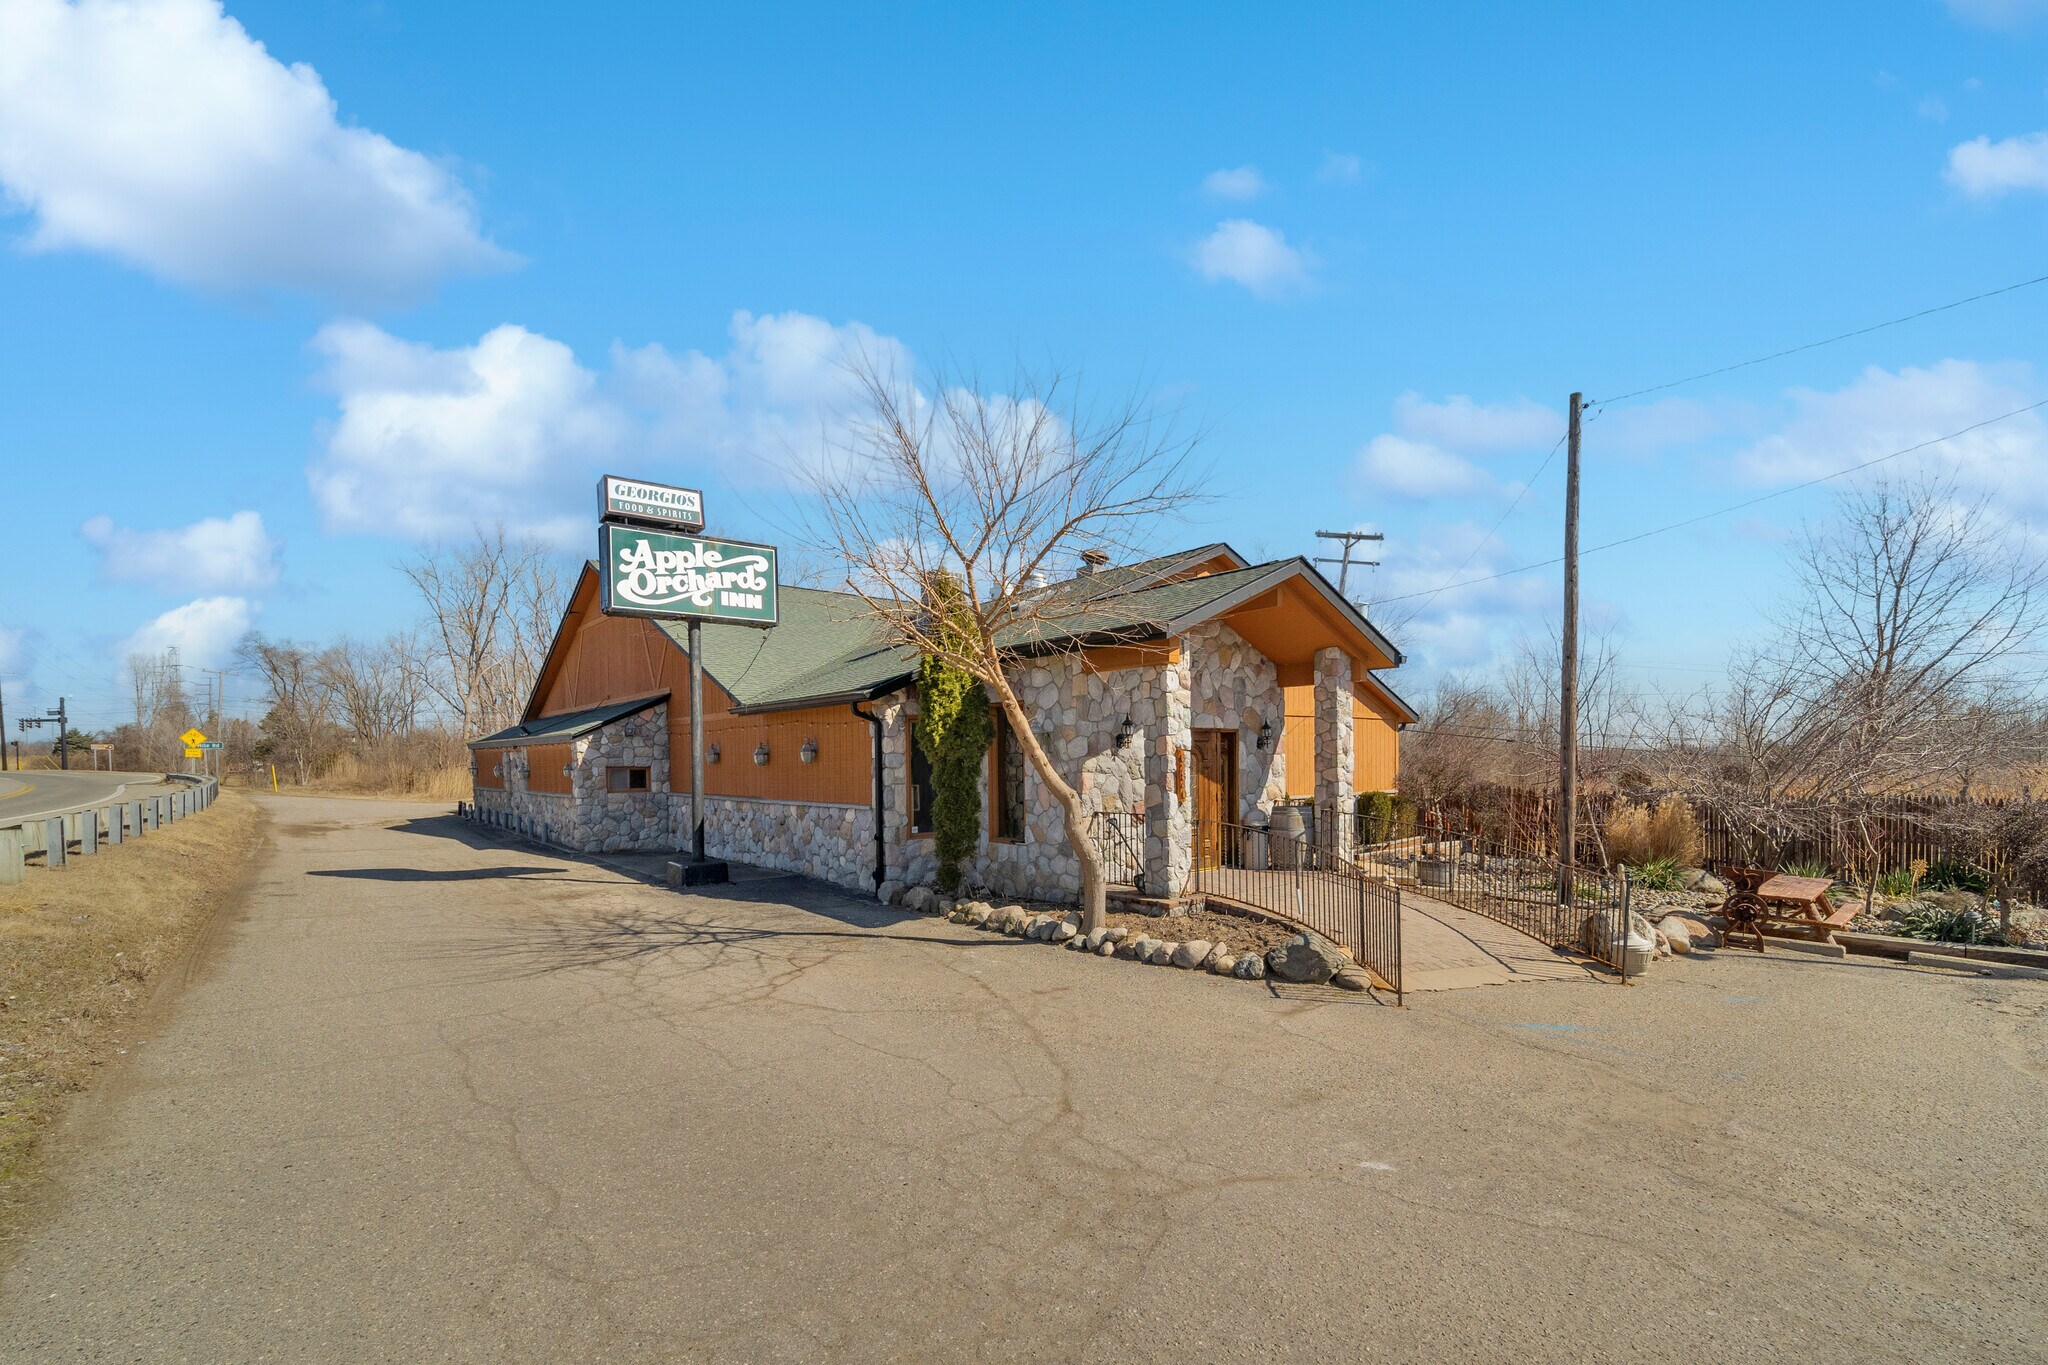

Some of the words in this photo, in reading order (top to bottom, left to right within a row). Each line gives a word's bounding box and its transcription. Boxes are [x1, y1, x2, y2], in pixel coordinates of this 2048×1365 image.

[619, 501, 644, 513] FOOD
[646, 506, 654, 514] &
[657, 507, 693, 521] SPIRITS
[619, 539, 769, 575] Apple
[617, 565, 767, 607] Orchard
[720, 591, 763, 610] INN
